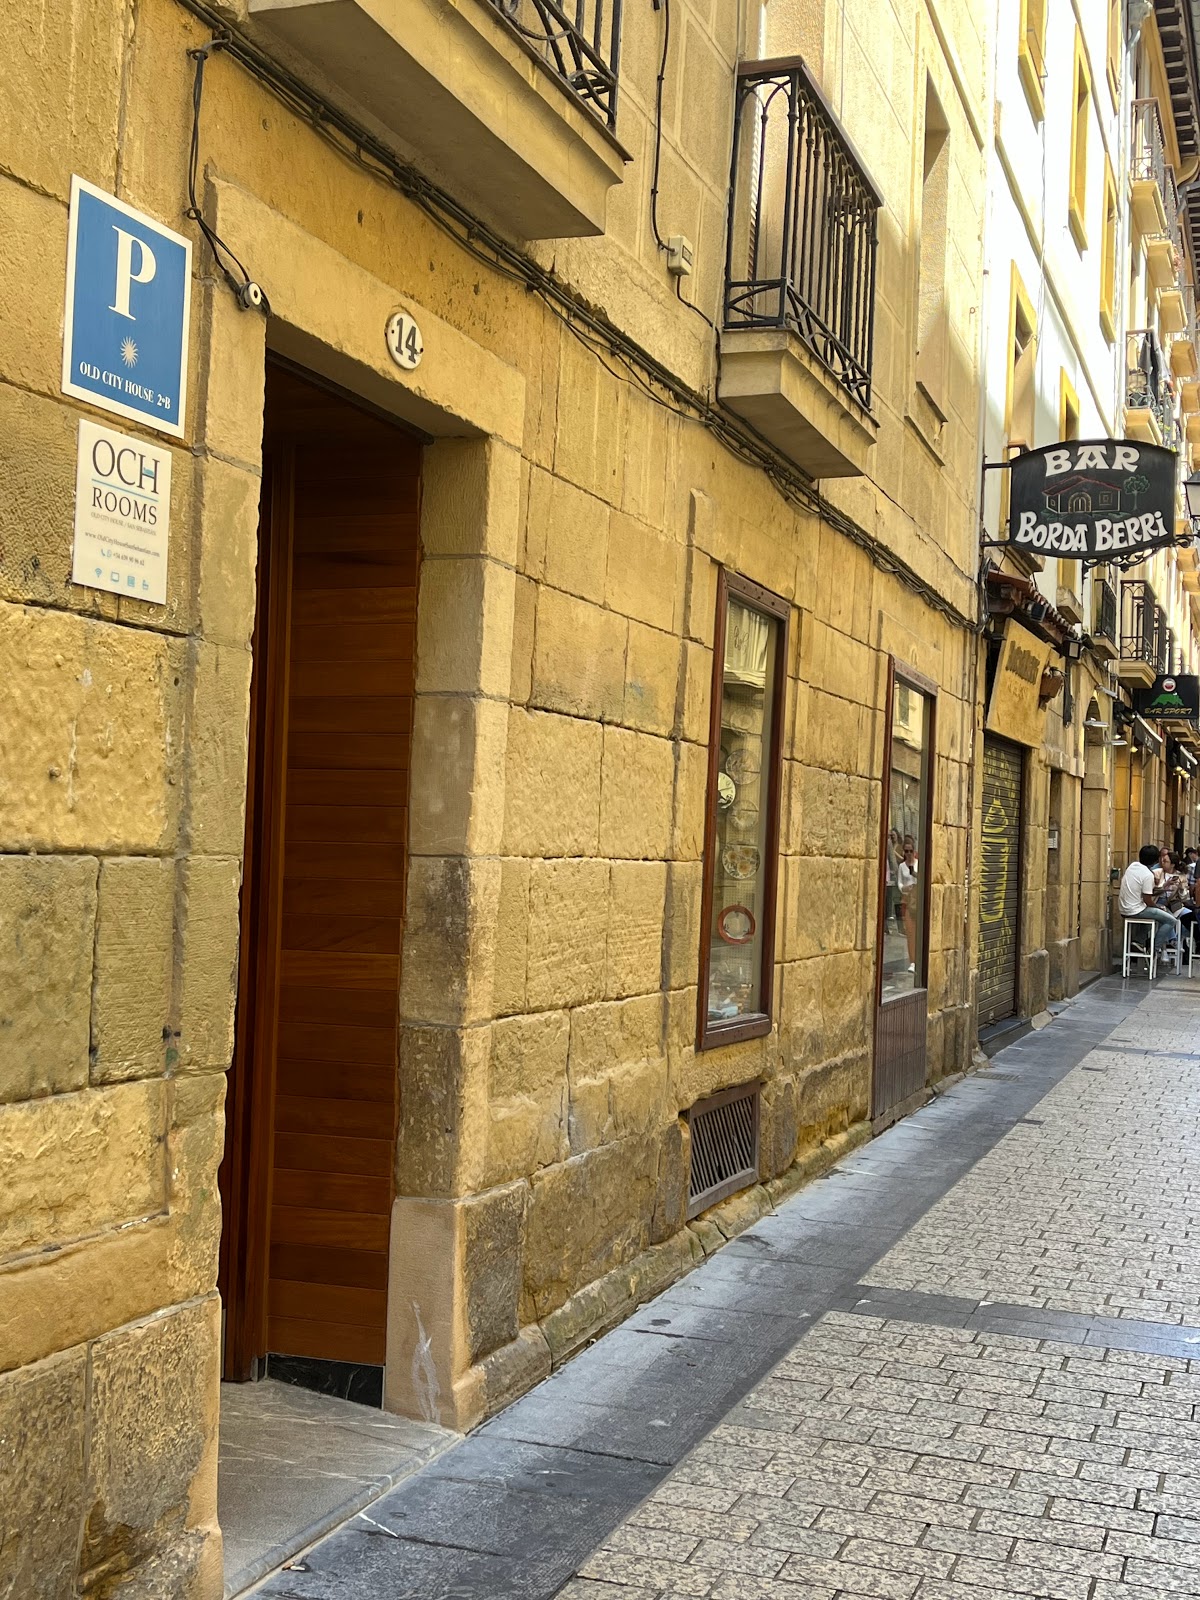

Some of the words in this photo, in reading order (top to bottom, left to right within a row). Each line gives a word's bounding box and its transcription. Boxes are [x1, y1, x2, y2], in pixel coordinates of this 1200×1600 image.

[108, 225, 157, 321] P
[395, 317, 417, 364] 14
[79, 361, 100, 380] OLD
[102, 370, 124, 390] CITY
[124, 379, 155, 404] HOUSE
[92, 439, 160, 495] OCH
[1043, 445, 1140, 477] BAR
[91, 486, 157, 525] ROOMS
[1015, 511, 1089, 552] BORDA
[1144, 707, 1162, 715] BAR
[1163, 707, 1193, 715] SPORT
